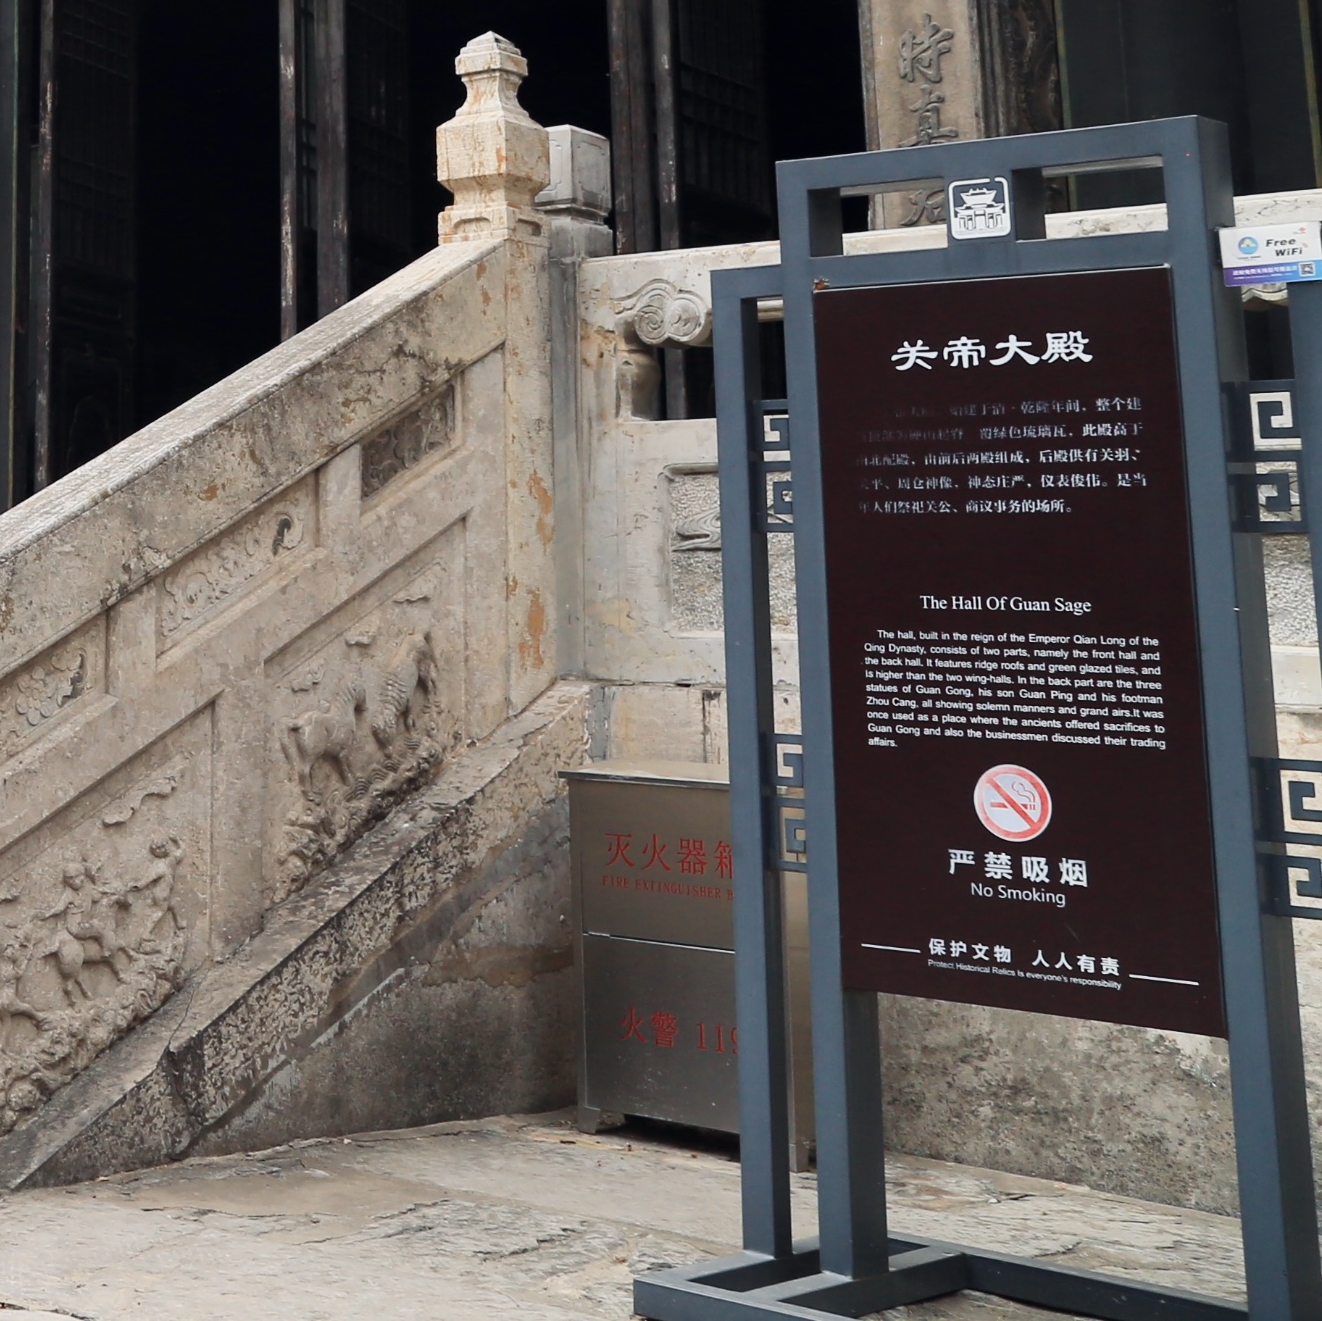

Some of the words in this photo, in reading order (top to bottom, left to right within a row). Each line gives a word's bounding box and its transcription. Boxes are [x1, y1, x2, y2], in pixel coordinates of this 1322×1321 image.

[1265, 238, 1297, 248] Free
[1275, 247, 1303, 257] WiFi
[890, 330, 1094, 371] 关帝大殿
[919, 595, 948, 610] The
[951, 595, 983, 611] Hall
[986, 596, 1008, 611] Of
[1009, 596, 1051, 612] Guan
[1054, 597, 1092, 616] Sage
[876, 629, 895, 639] The
[919, 630, 939, 640] built
[941, 630, 950, 640] in
[952, 631, 968, 641] the
[970, 633, 995, 644] reign
[997, 632, 1008, 642] of
[1009, 633, 1026, 643] the
[1028, 633, 1071, 645] Emperor
[1073, 634, 1098, 645] Qian
[1100, 635, 1126, 648] Long
[1128, 635, 1140, 646] of
[1142, 636, 1159, 647] the
[863, 642, 886, 654] Qing
[929, 645, 968, 655] consists
[970, 645, 980, 655] of
[982, 646, 1001, 656] two
[1033, 648, 1070, 660] namely
[1072, 649, 1089, 659] the
[1091, 649, 1116, 660] front
[1118, 650, 1137, 660] hall
[1140, 651, 1160, 661] and
[864, 656, 879, 666] the
[881, 656, 903, 666] back
[926, 658, 933, 668] It
[934, 658, 973, 669] features
[974, 659, 999, 672] ridge
[1000, 660, 1025, 671] roofs
[1027, 662, 1046, 671] and
[1048, 663, 1077, 674] green
[1079, 663, 1113, 675] glazed
[1141, 666, 1162, 676] and
[875, 670, 904, 681] higher
[905, 671, 926, 681] than
[928, 672, 944, 682] the
[945, 673, 963, 682] two
[1017, 675, 1027, 685] In
[1029, 676, 1046, 686] the
[1047, 676, 1072, 687] back
[1074, 678, 1095, 688] part
[1096, 679, 1114, 688] are
[1115, 679, 1133, 689] the
[1135, 680, 1162, 690] three
[865, 683, 899, 693] statues
[902, 684, 912, 694] of
[915, 684, 941, 695] Guan
[978, 687, 993, 697] his
[996, 689, 1015, 698] son
[1018, 688, 1046, 699] Guan
[1050, 690, 1073, 703] Ping
[1077, 692, 1097, 702] and
[1101, 692, 1117, 703] his
[1121, 693, 1164, 704] footman
[866, 695, 890, 706] Zhou
[921, 698, 933, 708] all
[935, 699, 974, 712] showing
[975, 701, 1011, 712] solemn
[1012, 704, 1056, 714] manners
[1057, 705, 1077, 715] and
[1079, 706, 1109, 718] grand
[1142, 710, 1165, 719] was
[866, 711, 889, 720] once
[891, 711, 915, 721] used
[917, 713, 929, 722] as
[931, 714, 939, 722] a
[941, 713, 967, 724] place
[969, 714, 1000, 725] where
[1002, 716, 1018, 726] the
[1021, 717, 1063, 729] ancients
[1065, 719, 1100, 731] offered
[1103, 722, 1152, 733] sacrifices
[1154, 724, 1166, 734] to
[867, 722, 893, 733] Guan
[895, 724, 921, 737] Gong
[923, 726, 941, 736] and
[944, 727, 964, 737] also
[966, 728, 983, 739] the
[985, 729, 1049, 742] businessmen
[1051, 732, 1101, 745] discussed
[1103, 735, 1127, 746] their
[1130, 737, 1166, 751] trading
[603, 832, 735, 879] 灭火器箱
[947, 848, 1089, 888] 严禁吸烟
[602, 875, 630, 890] FIRE
[635, 879, 723, 901] EXTINGUISHER
[970, 882, 994, 898] No
[997, 884, 1066, 908] Smoking
[928, 938, 1012, 964] 保护文物
[1032, 949, 1121, 977] 人人有责
[619, 1006, 679, 1048] 火警
